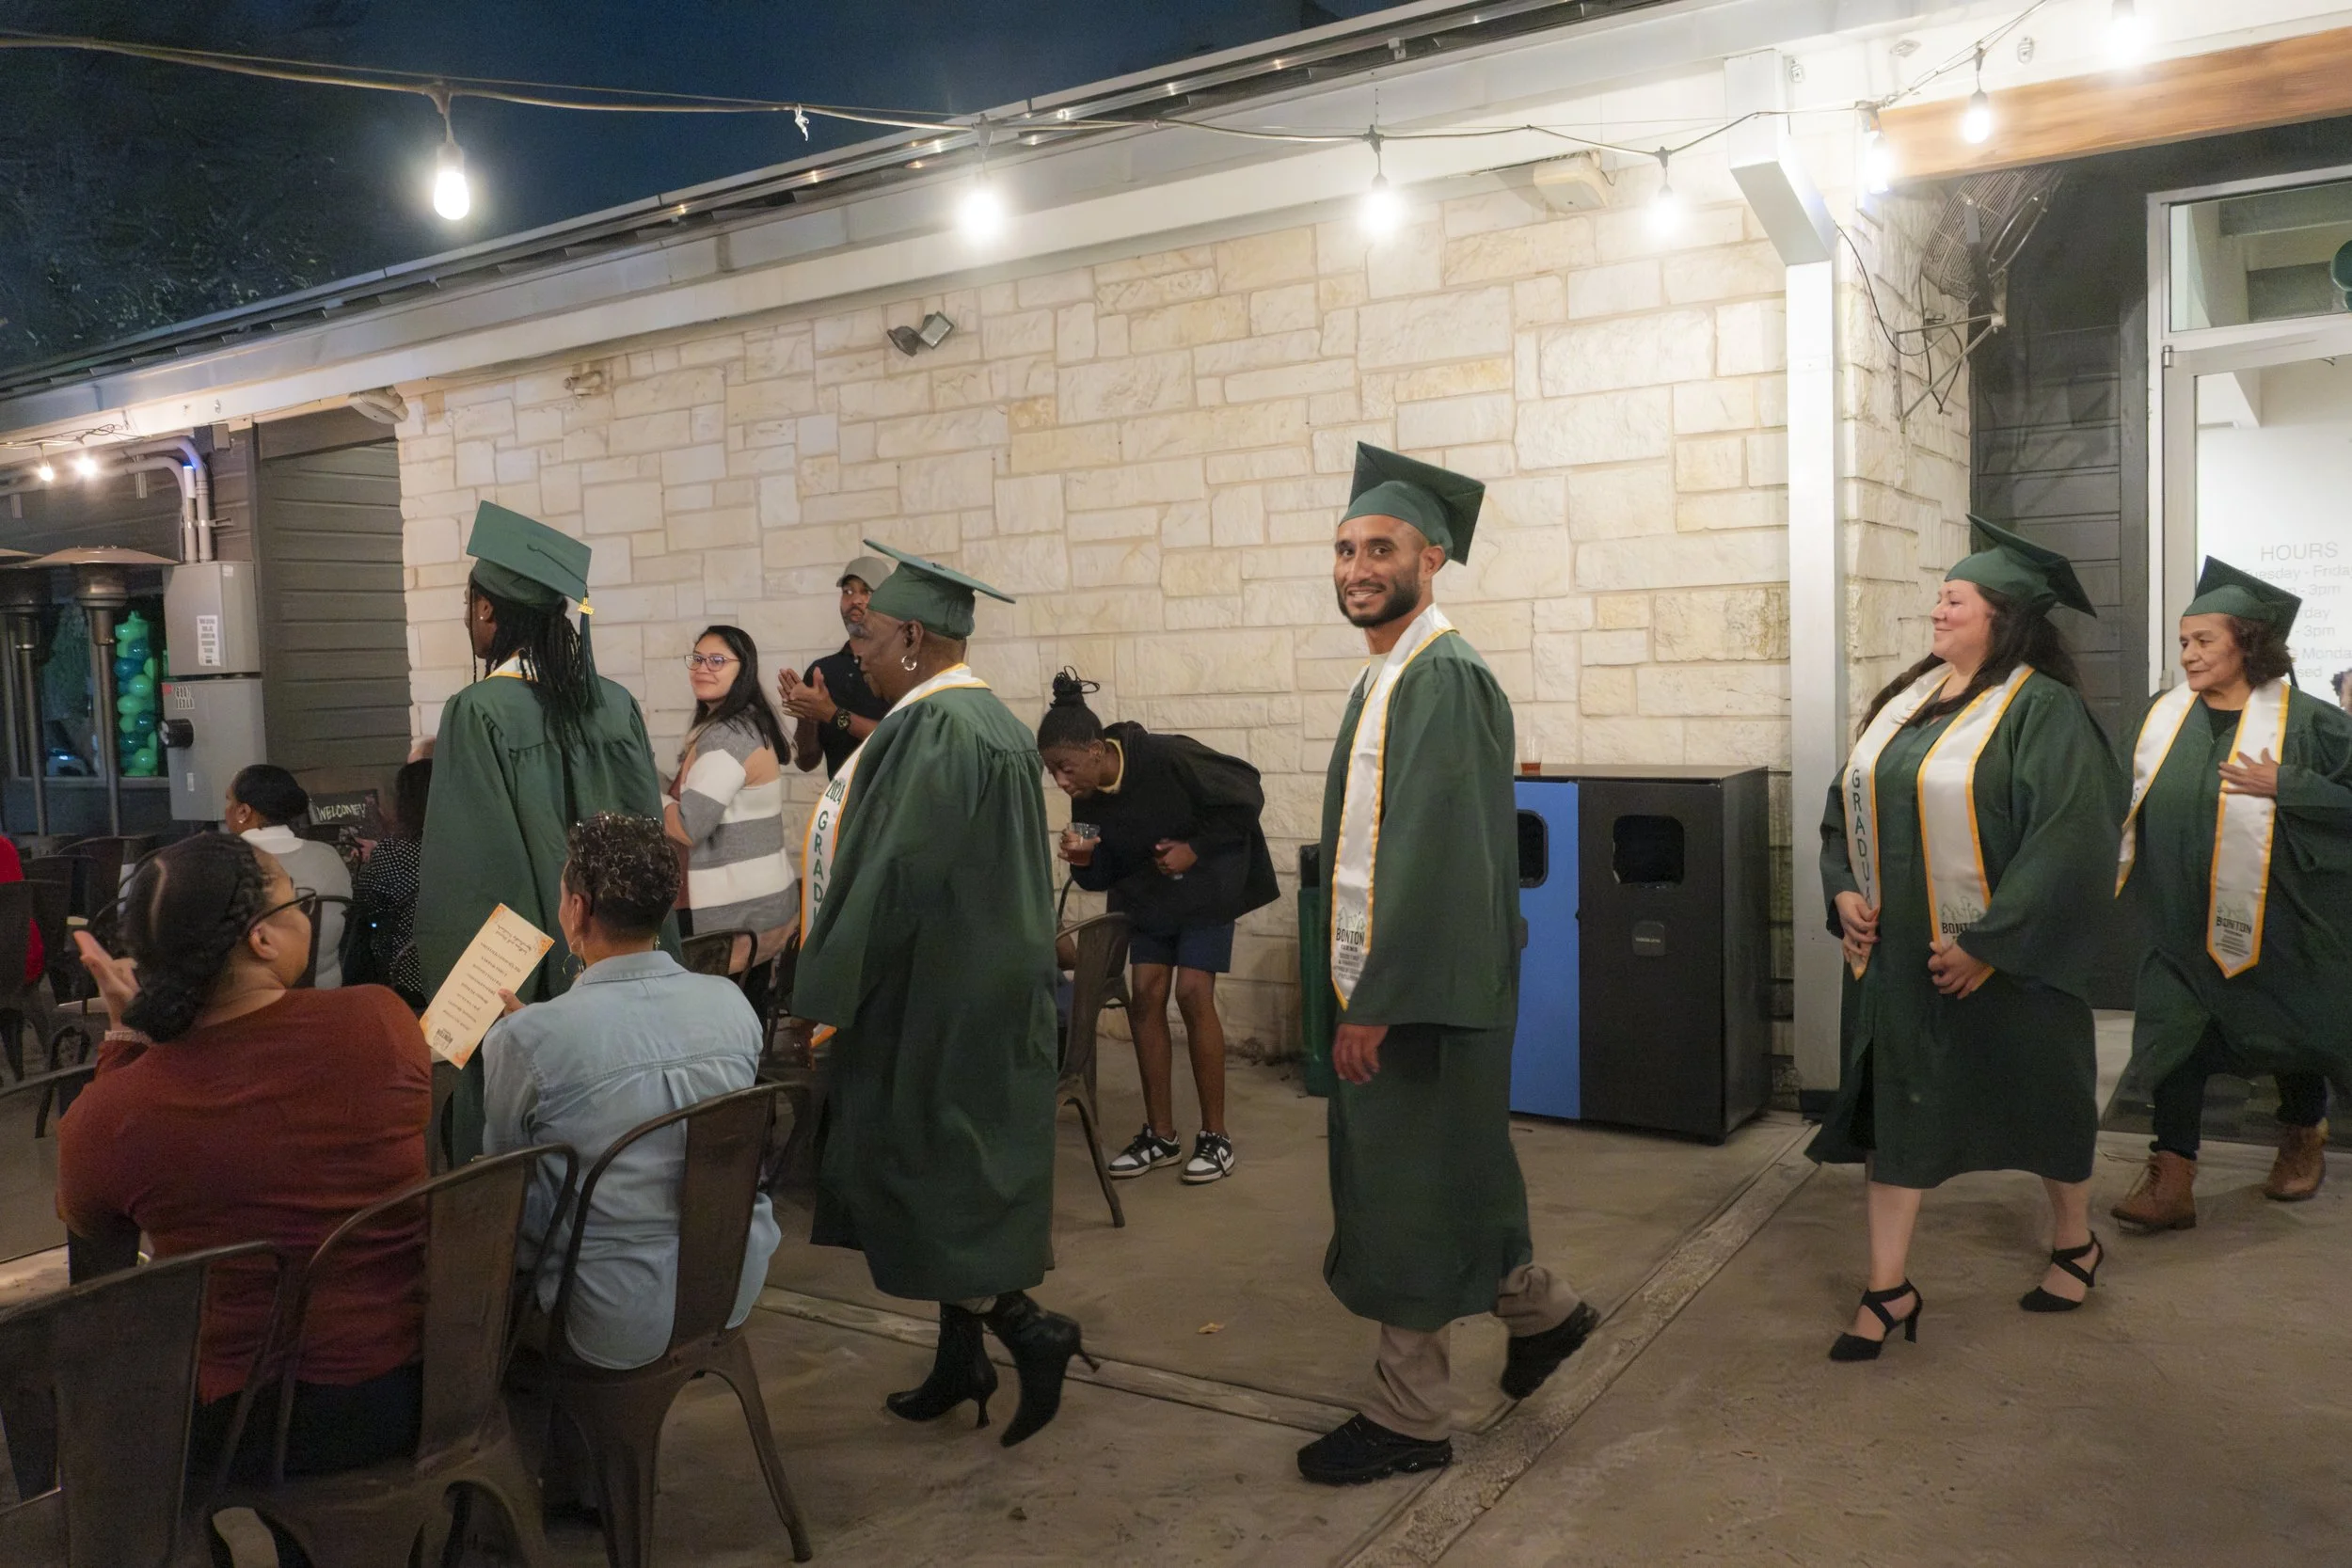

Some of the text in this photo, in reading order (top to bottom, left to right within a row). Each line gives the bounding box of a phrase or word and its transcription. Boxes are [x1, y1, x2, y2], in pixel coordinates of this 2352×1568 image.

[2260, 542, 2339, 562] HOURS
[2309, 584, 2342, 597] 3pm
[2298, 607, 2331, 620] rday
[2303, 625, 2335, 637] 3pm
[2302, 647, 2352, 659] Monda
[2297, 665, 2323, 678] sed
[825, 778, 846, 806] 2024
[1851, 768, 1873, 910] GRADUA
[813, 810, 829, 921] GRAD
[1336, 927, 1365, 946] BONTON
